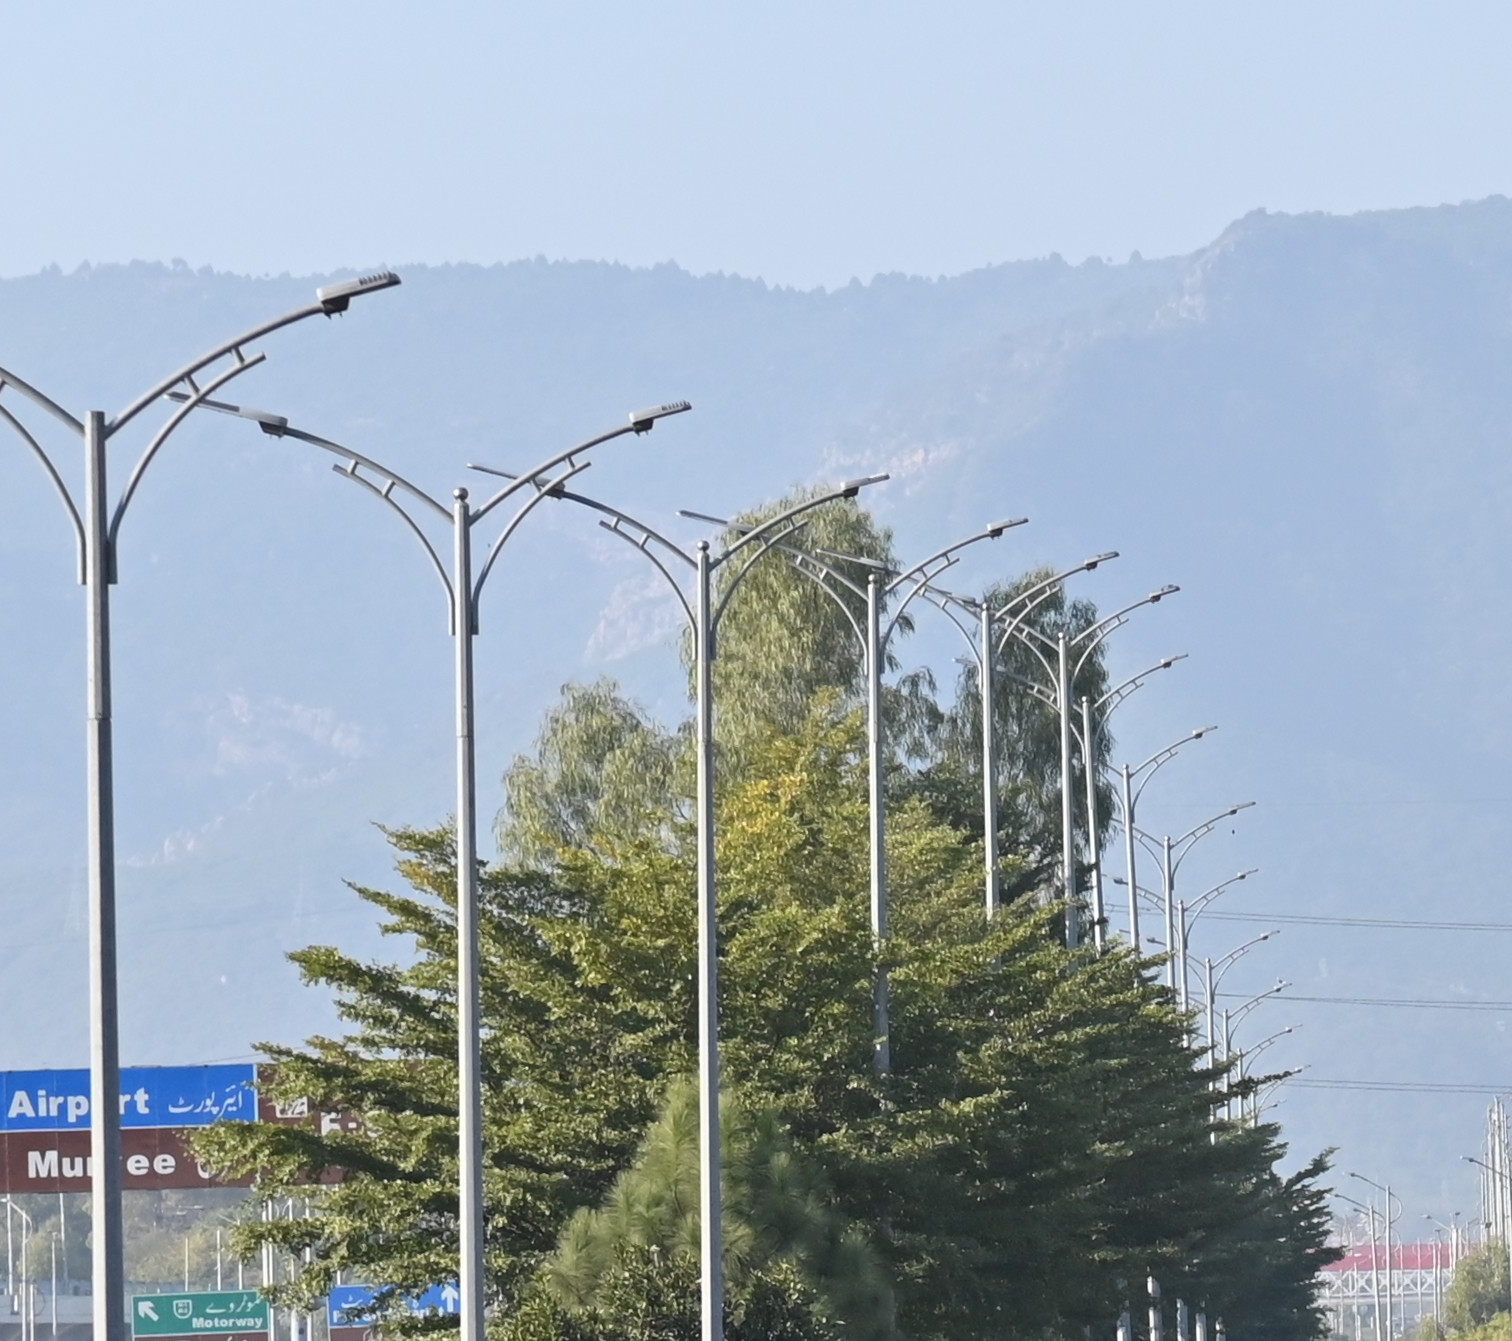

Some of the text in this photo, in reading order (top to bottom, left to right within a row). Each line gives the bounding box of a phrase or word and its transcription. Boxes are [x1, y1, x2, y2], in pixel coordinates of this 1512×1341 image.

[7, 1087, 150, 1123] Airprt
[27, 1150, 177, 1179] Muee
[191, 1316, 263, 1329] Motorway
